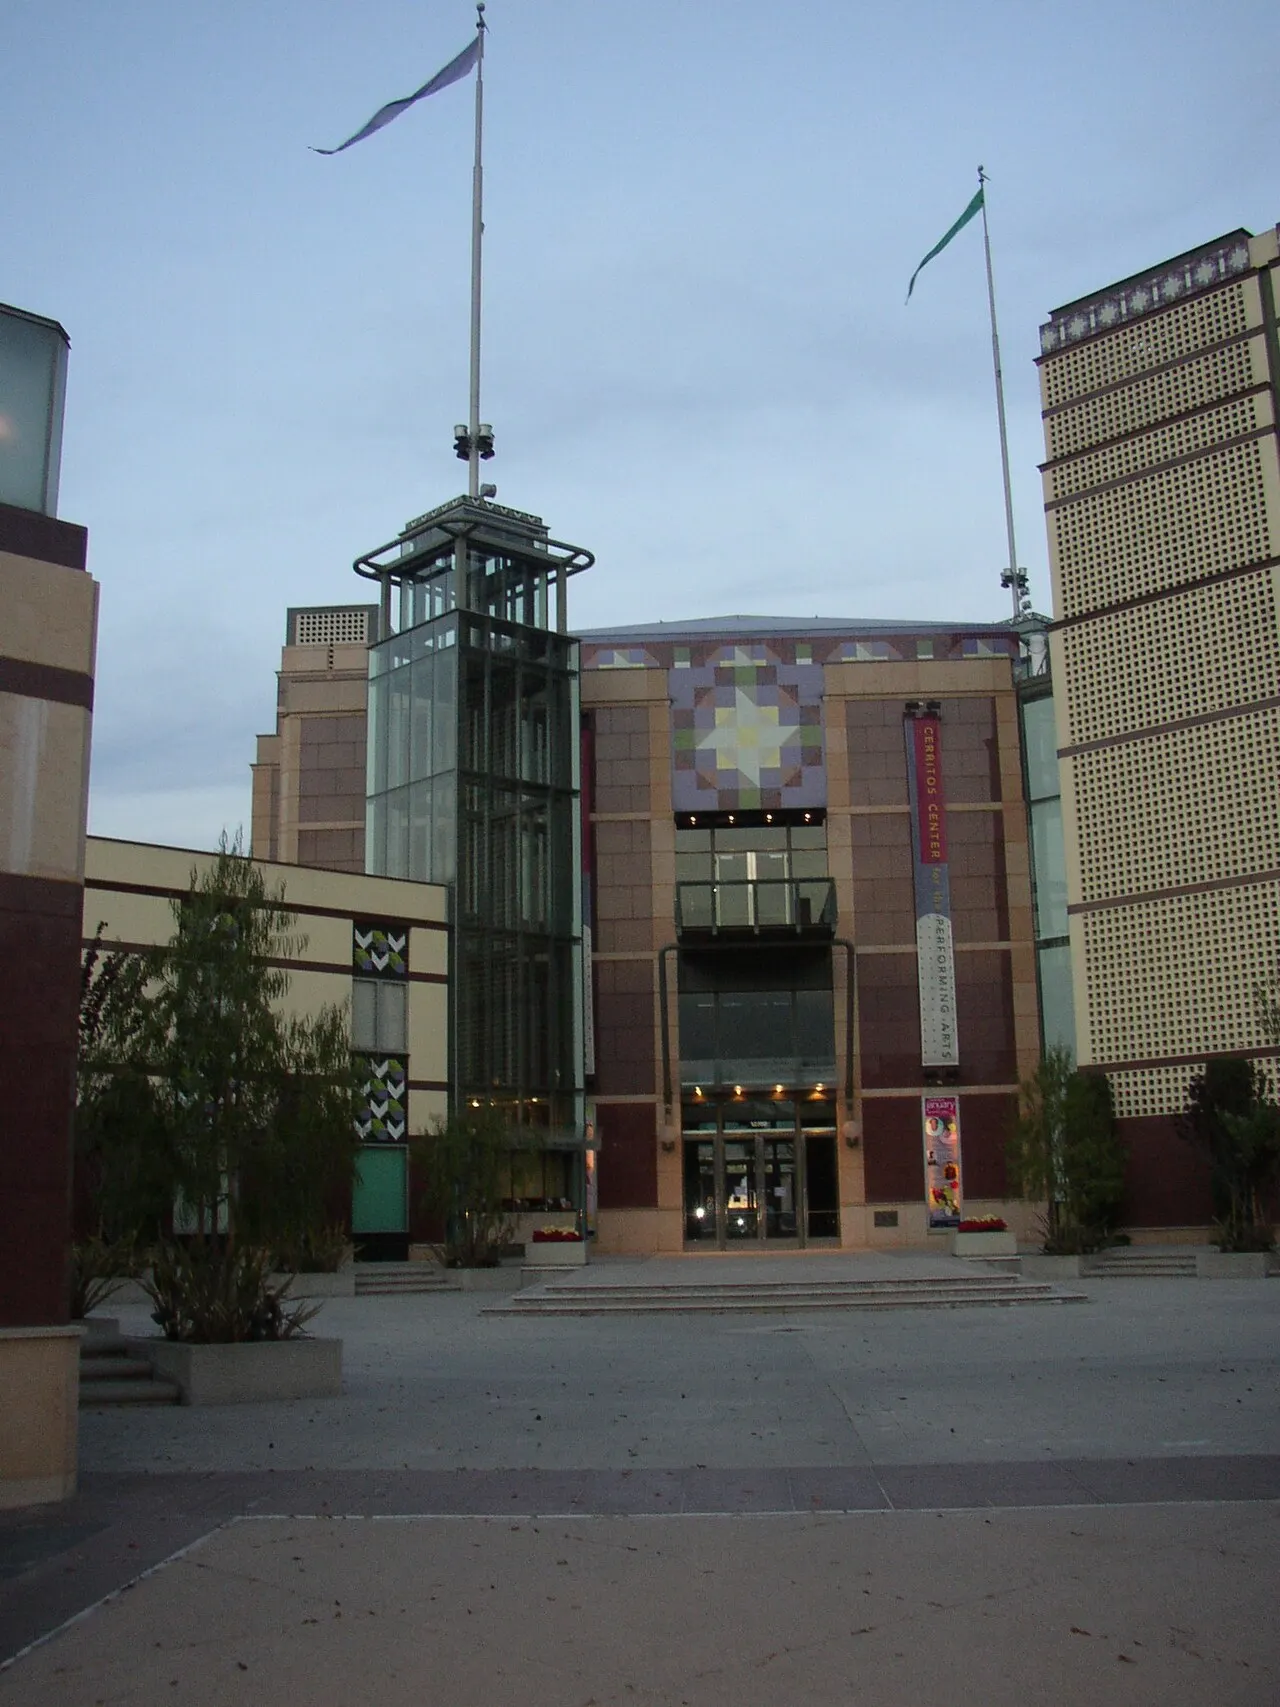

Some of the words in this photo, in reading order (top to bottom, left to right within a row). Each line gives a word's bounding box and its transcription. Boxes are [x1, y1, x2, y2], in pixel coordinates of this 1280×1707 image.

[924, 727, 937, 795] CERRITOS
[928, 803, 941, 859] CENTER
[935, 918, 950, 1014] PERFORMING
[941, 1022, 952, 1059] ARTS
